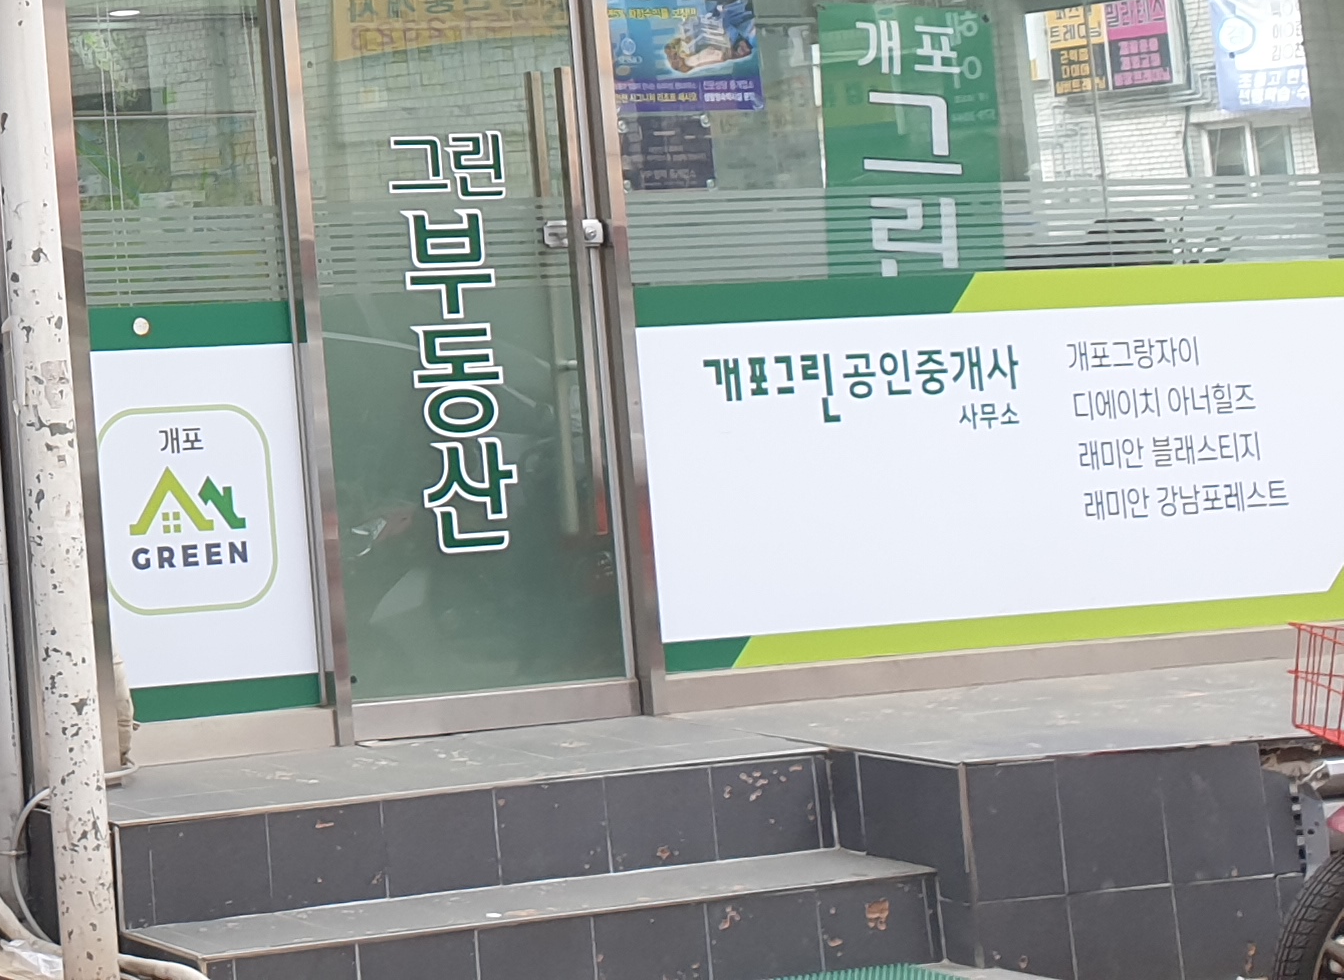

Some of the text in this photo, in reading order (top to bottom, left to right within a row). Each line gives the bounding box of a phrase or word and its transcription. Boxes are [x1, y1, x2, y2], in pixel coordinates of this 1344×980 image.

[855, 20, 962, 75] 개포
[388, 130, 506, 200] 그린
[1066, 336, 1201, 371] 개포그랑자이
[401, 207, 518, 554] 부동산
[958, 402, 1020, 430] 사무소
[1073, 382, 1257, 421] 디에이치 아너힐즈
[159, 427, 204, 454] 개포
[1078, 431, 1262, 471] 래미안 블래스티지
[1083, 479, 1290, 521] 래미안 강남포레스트
[131, 540, 249, 571] GREEN
